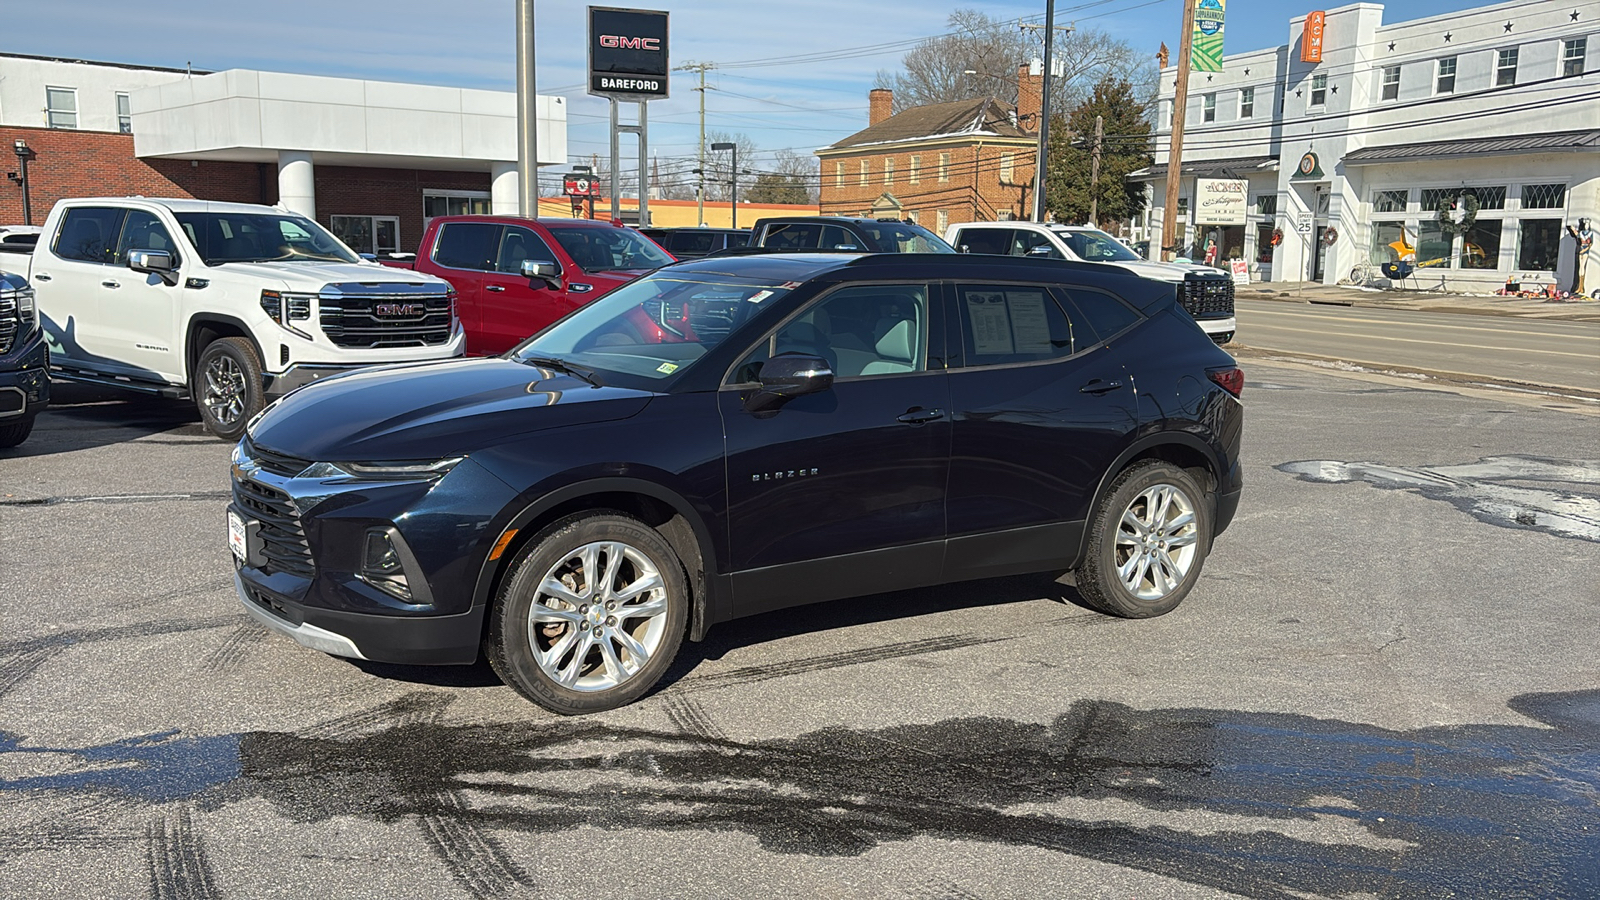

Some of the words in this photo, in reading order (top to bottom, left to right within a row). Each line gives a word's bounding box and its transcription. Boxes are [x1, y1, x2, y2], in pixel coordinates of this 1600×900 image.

[1195, 10, 1225, 20] TAPPAHANNOCK
[600, 34, 660, 50] GMC
[1312, 14, 1321, 58] ACME
[601, 77, 659, 90] BAREFORD
[1205, 181, 1242, 192] ACME
[1298, 223, 1311, 231] 25
[376, 303, 424, 315] GMC
[752, 467, 818, 481] BLAZER
